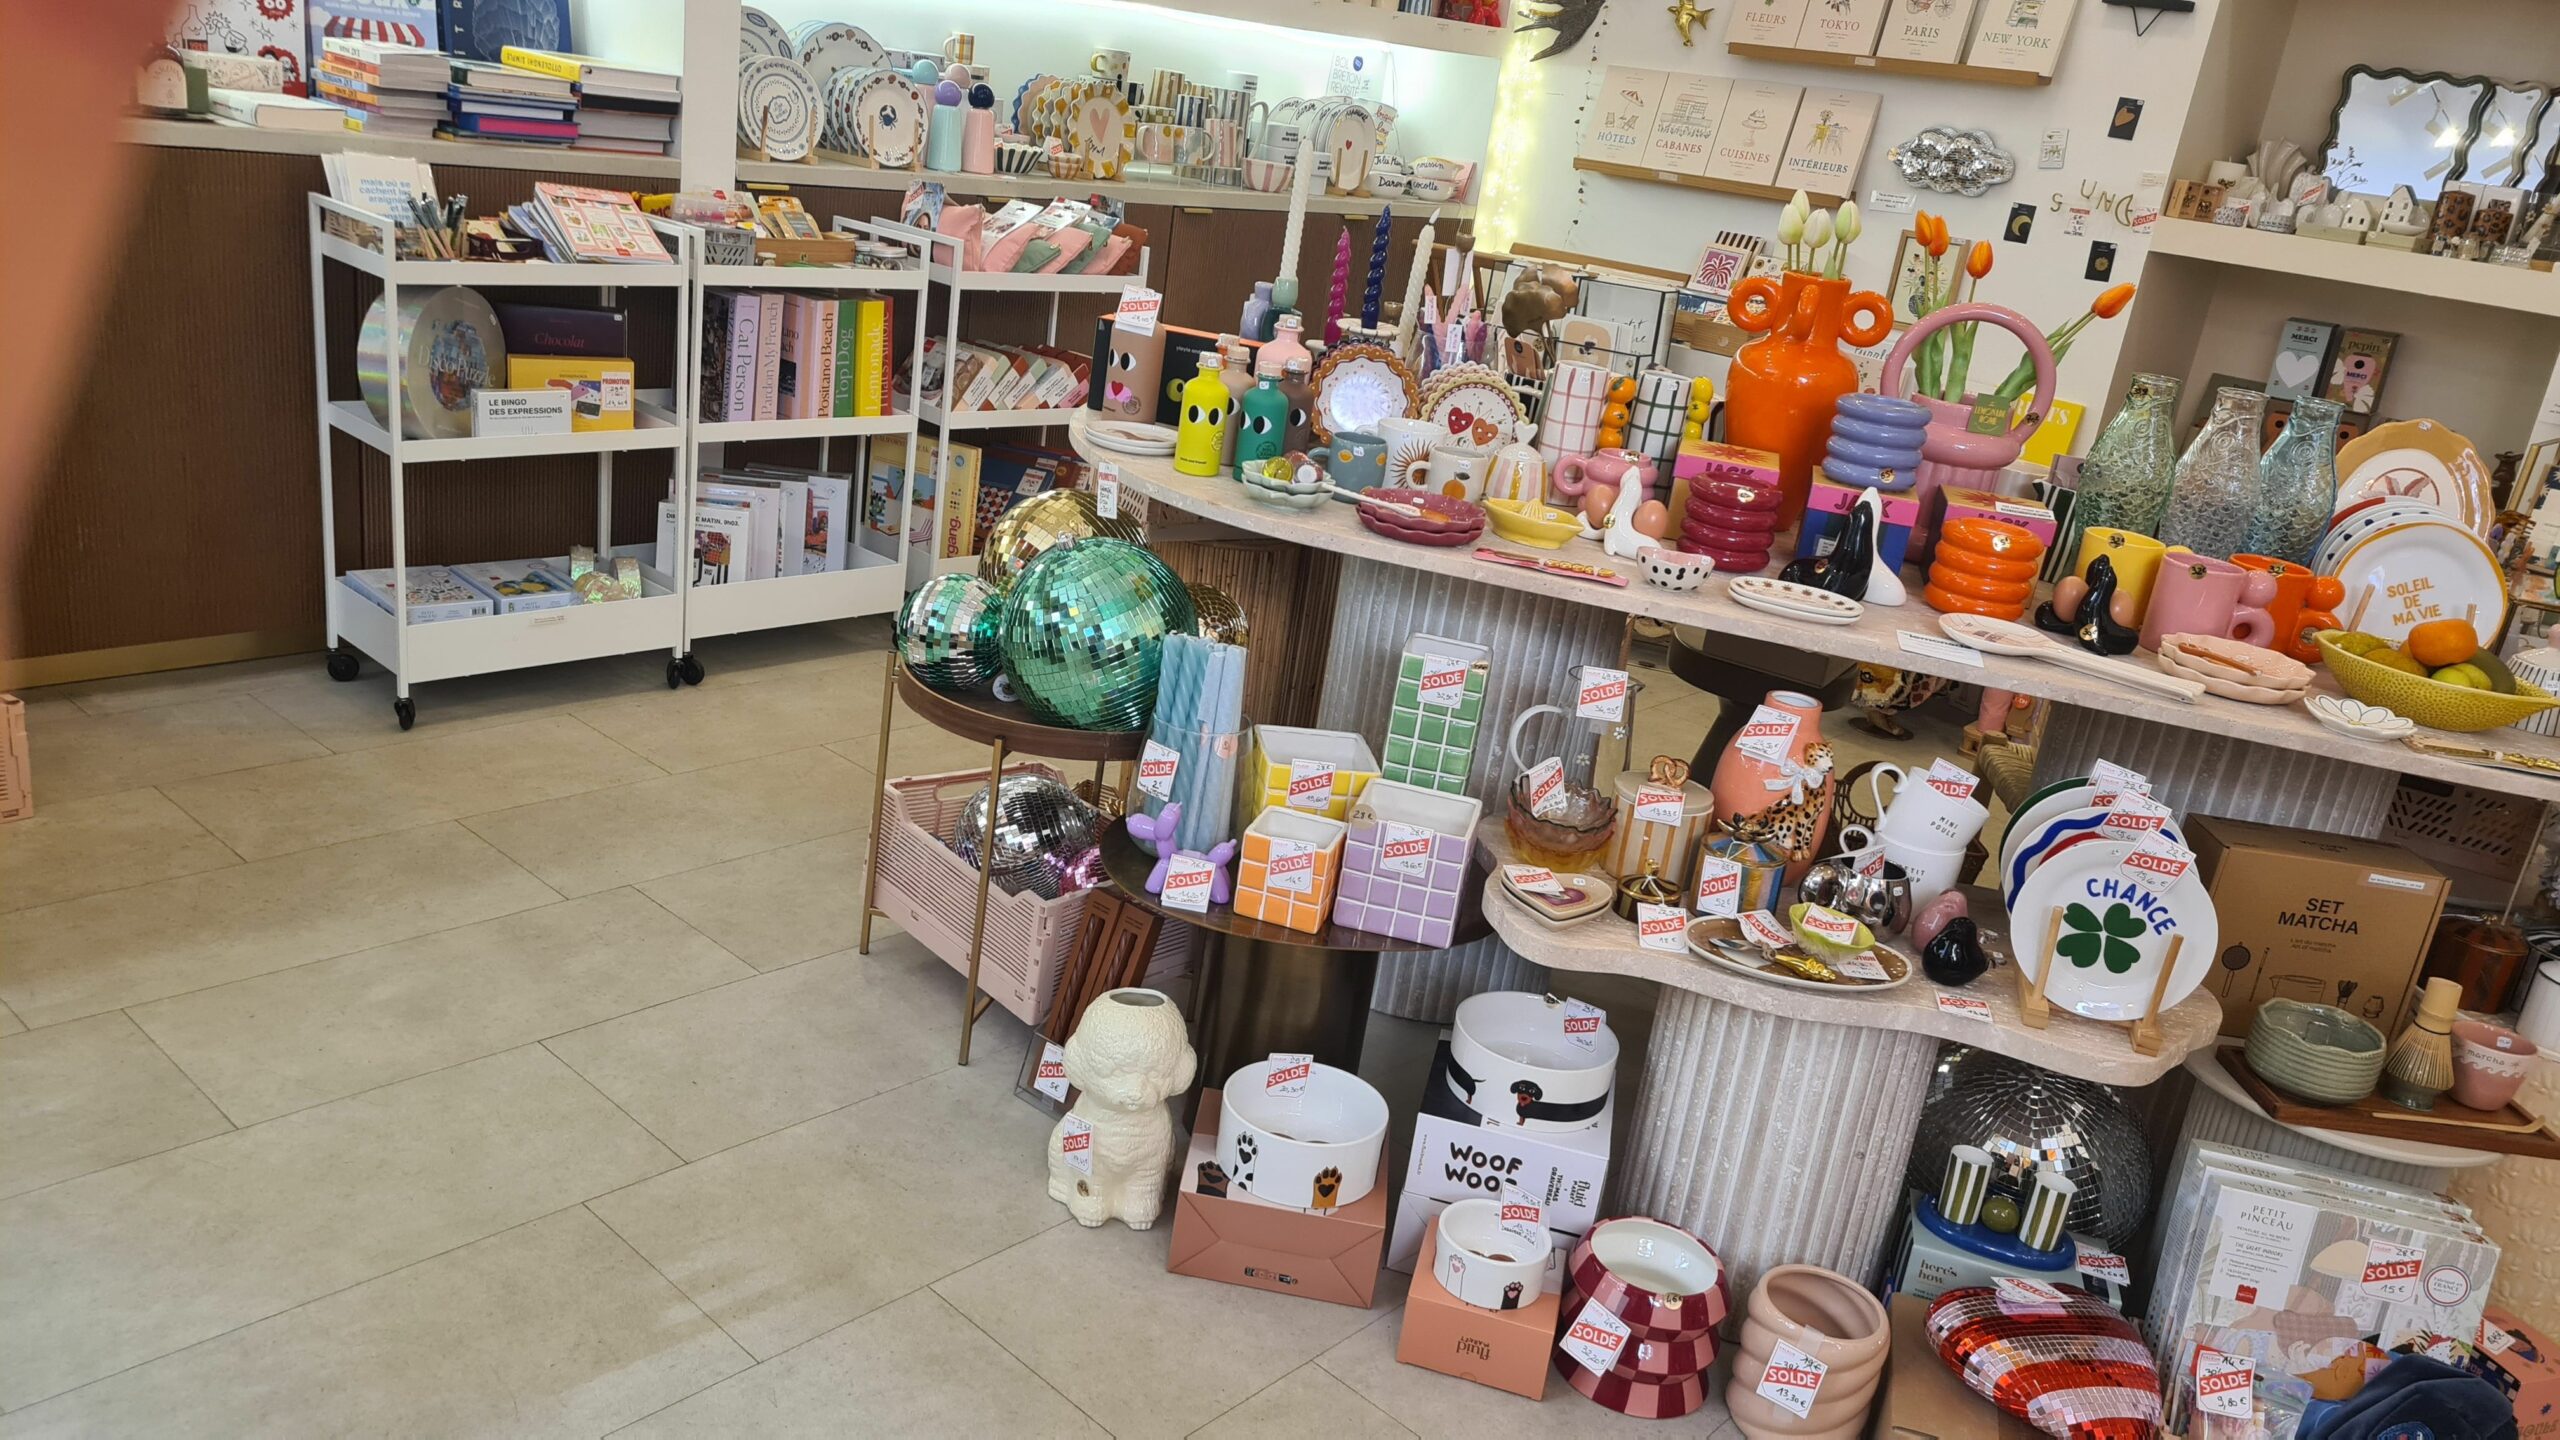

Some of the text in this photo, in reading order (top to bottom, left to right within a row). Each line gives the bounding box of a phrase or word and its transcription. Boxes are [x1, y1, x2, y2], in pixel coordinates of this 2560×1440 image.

[1745, 12, 1787, 25] FLEURS
[1819, 18, 1860, 32] TOKYO
[1904, 24, 1940, 38] PARIS
[1982, 32, 2051, 50] NEW YORK
[1597, 131, 1637, 146] HÔTELS
[1656, 139, 1703, 154] CABANES
[1720, 147, 1771, 164] CUISINES
[1788, 157, 1849, 174] INTÉRIEURS
[765, 302, 779, 346] French
[534, 332, 585, 349] Chocolat
[2291, 333, 2318, 343] MERCI
[733, 317, 755, 411] Cat Person
[817, 312, 834, 417] Positano Beach
[836, 328, 855, 404] Top Dog
[865, 320, 881, 411] Lemonade
[2346, 371, 2368, 380] MERCI
[761, 369, 775, 415] Pardon
[501, 398, 527, 406] BINGO
[489, 406, 563, 416] DES EXPRESSIONS
[2387, 576, 2435, 599] SOLEIL
[2403, 594, 2422, 610] DE
[2392, 604, 2443, 626] MA VIE
[1930, 820, 1957, 839] POULE
[1938, 815, 1958, 830] MINI
[2086, 878, 2177, 936] CHANCE
[2305, 898, 2345, 915] SET
[2278, 911, 2359, 936] MATCHA
[1450, 1142, 1523, 1175] WOOF
[1545, 1166, 1559, 1206] GRAVEREAU
[1574, 1180, 1591, 1208] fluid
[2252, 1205, 2287, 1220] PETIT
[2240, 1212, 2294, 1231] PINCEAU
[1921, 1259, 1957, 1277] here's
[1919, 1270, 1943, 1284] how
[2433, 1281, 2459, 1293] FRANCE
[1456, 1341, 1490, 1361] fluid
